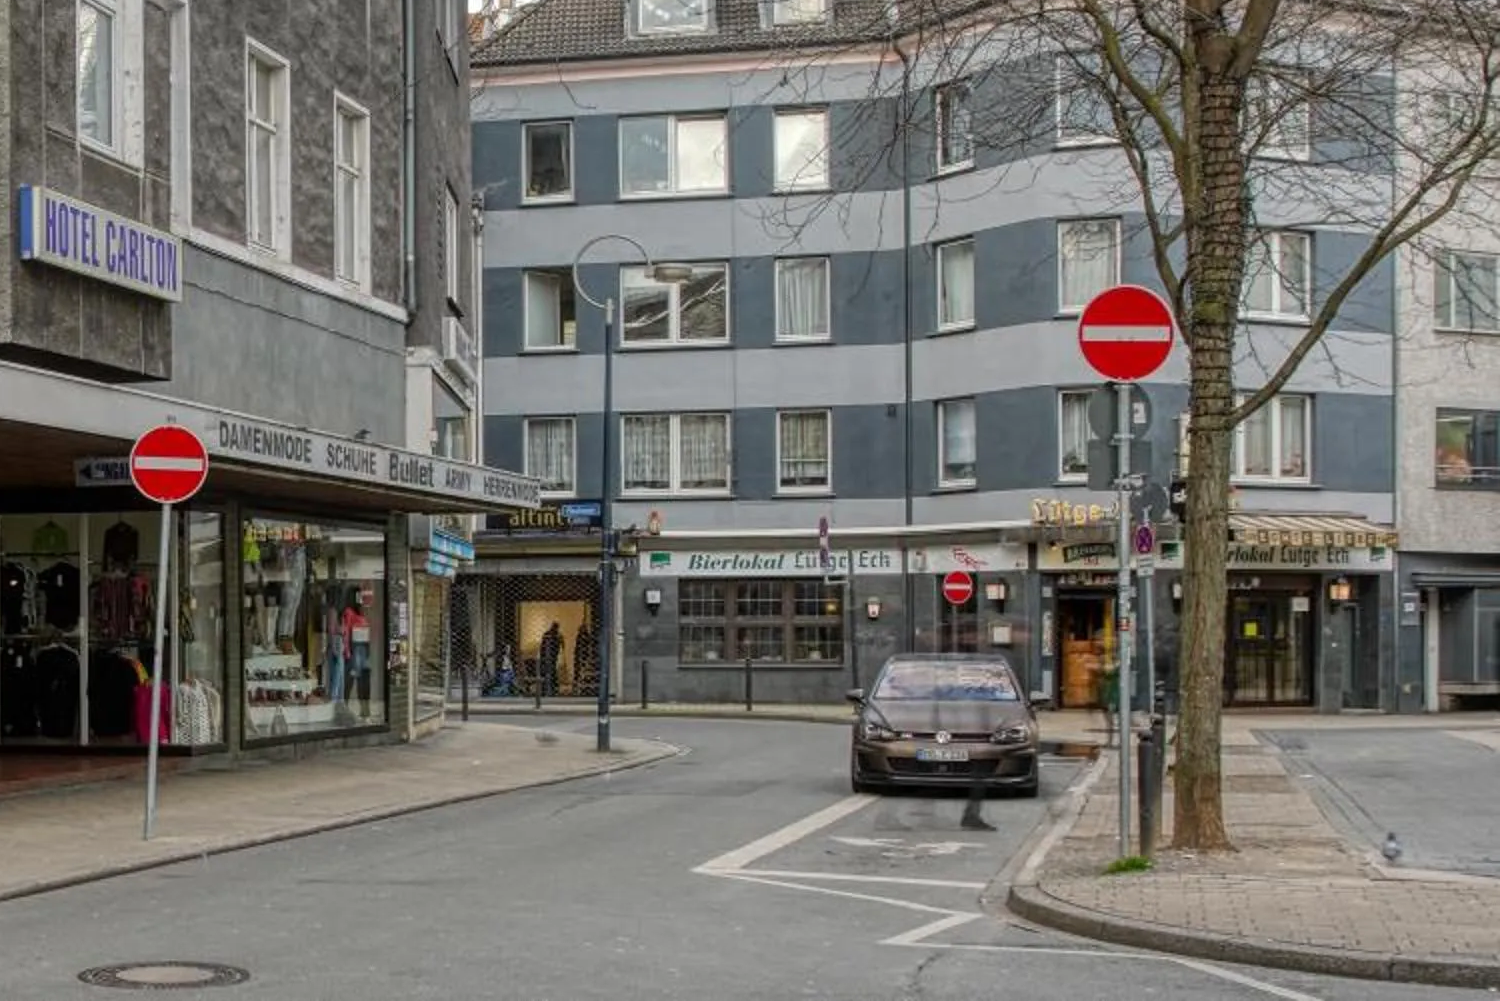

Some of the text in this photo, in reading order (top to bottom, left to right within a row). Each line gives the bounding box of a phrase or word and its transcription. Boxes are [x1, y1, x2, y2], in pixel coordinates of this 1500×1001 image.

[45, 198, 177, 292] HOTEL CARLTON
[219, 420, 313, 463] DAMENMODE
[326, 442, 377, 475] SCHUHE
[389, 452, 435, 488] Bullet
[687, 553, 785, 571] Bierlokal
